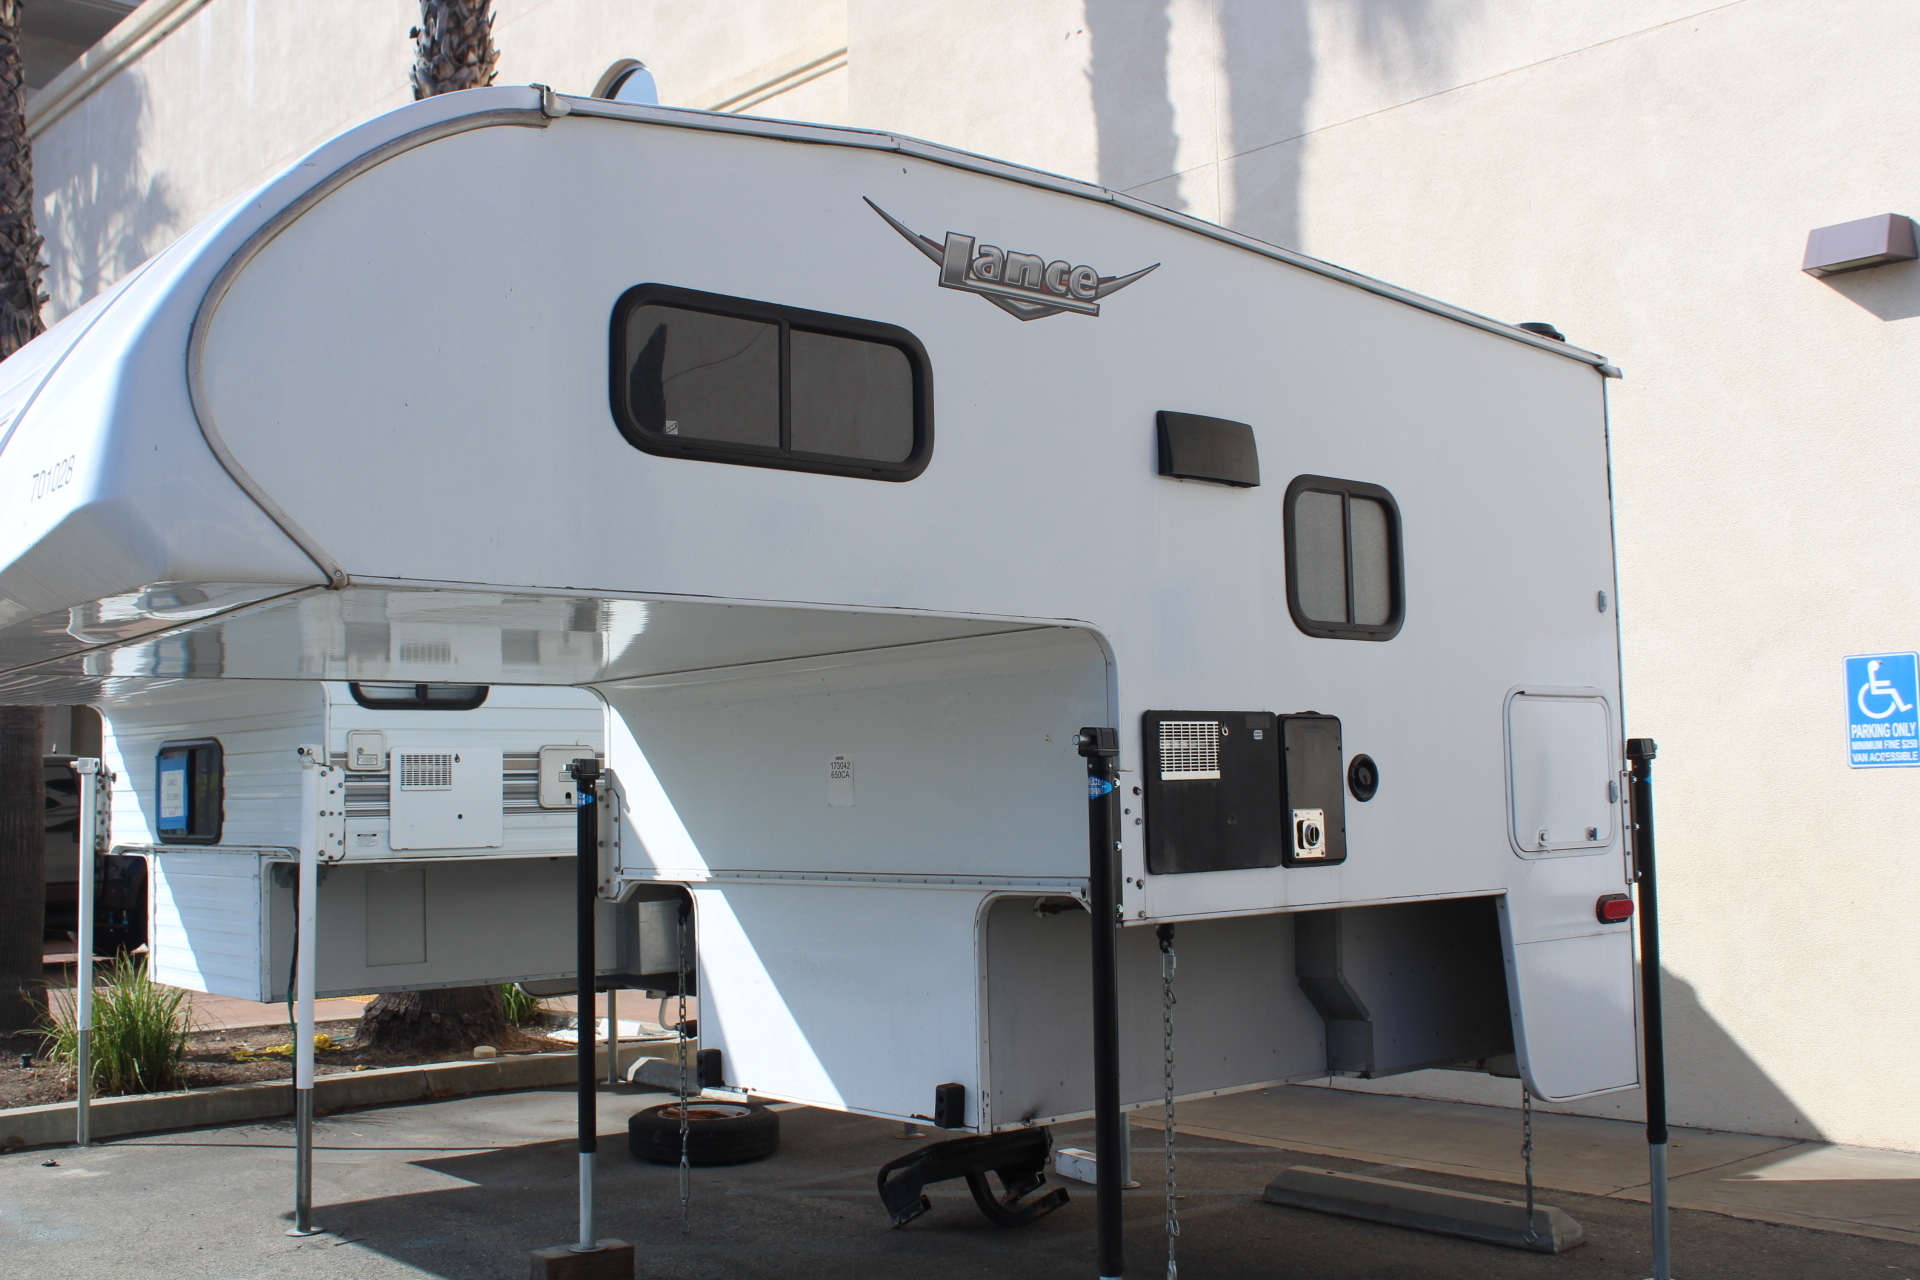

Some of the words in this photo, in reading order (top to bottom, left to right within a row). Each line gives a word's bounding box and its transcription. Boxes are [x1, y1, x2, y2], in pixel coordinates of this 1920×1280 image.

[939, 231, 1100, 301] Lance
[31, 454, 75, 503] 701028
[1851, 723, 1890, 738] PARKING
[1892, 722, 1917, 737] ONLY
[1851, 740, 1883, 750] MINIMUM
[1884, 740, 1900, 749] FINE
[1901, 739, 1918, 749] $250
[1852, 753, 1868, 762] VAN
[1869, 751, 1918, 761] ACCESSIBLE
[830, 761, 851, 770] 173042
